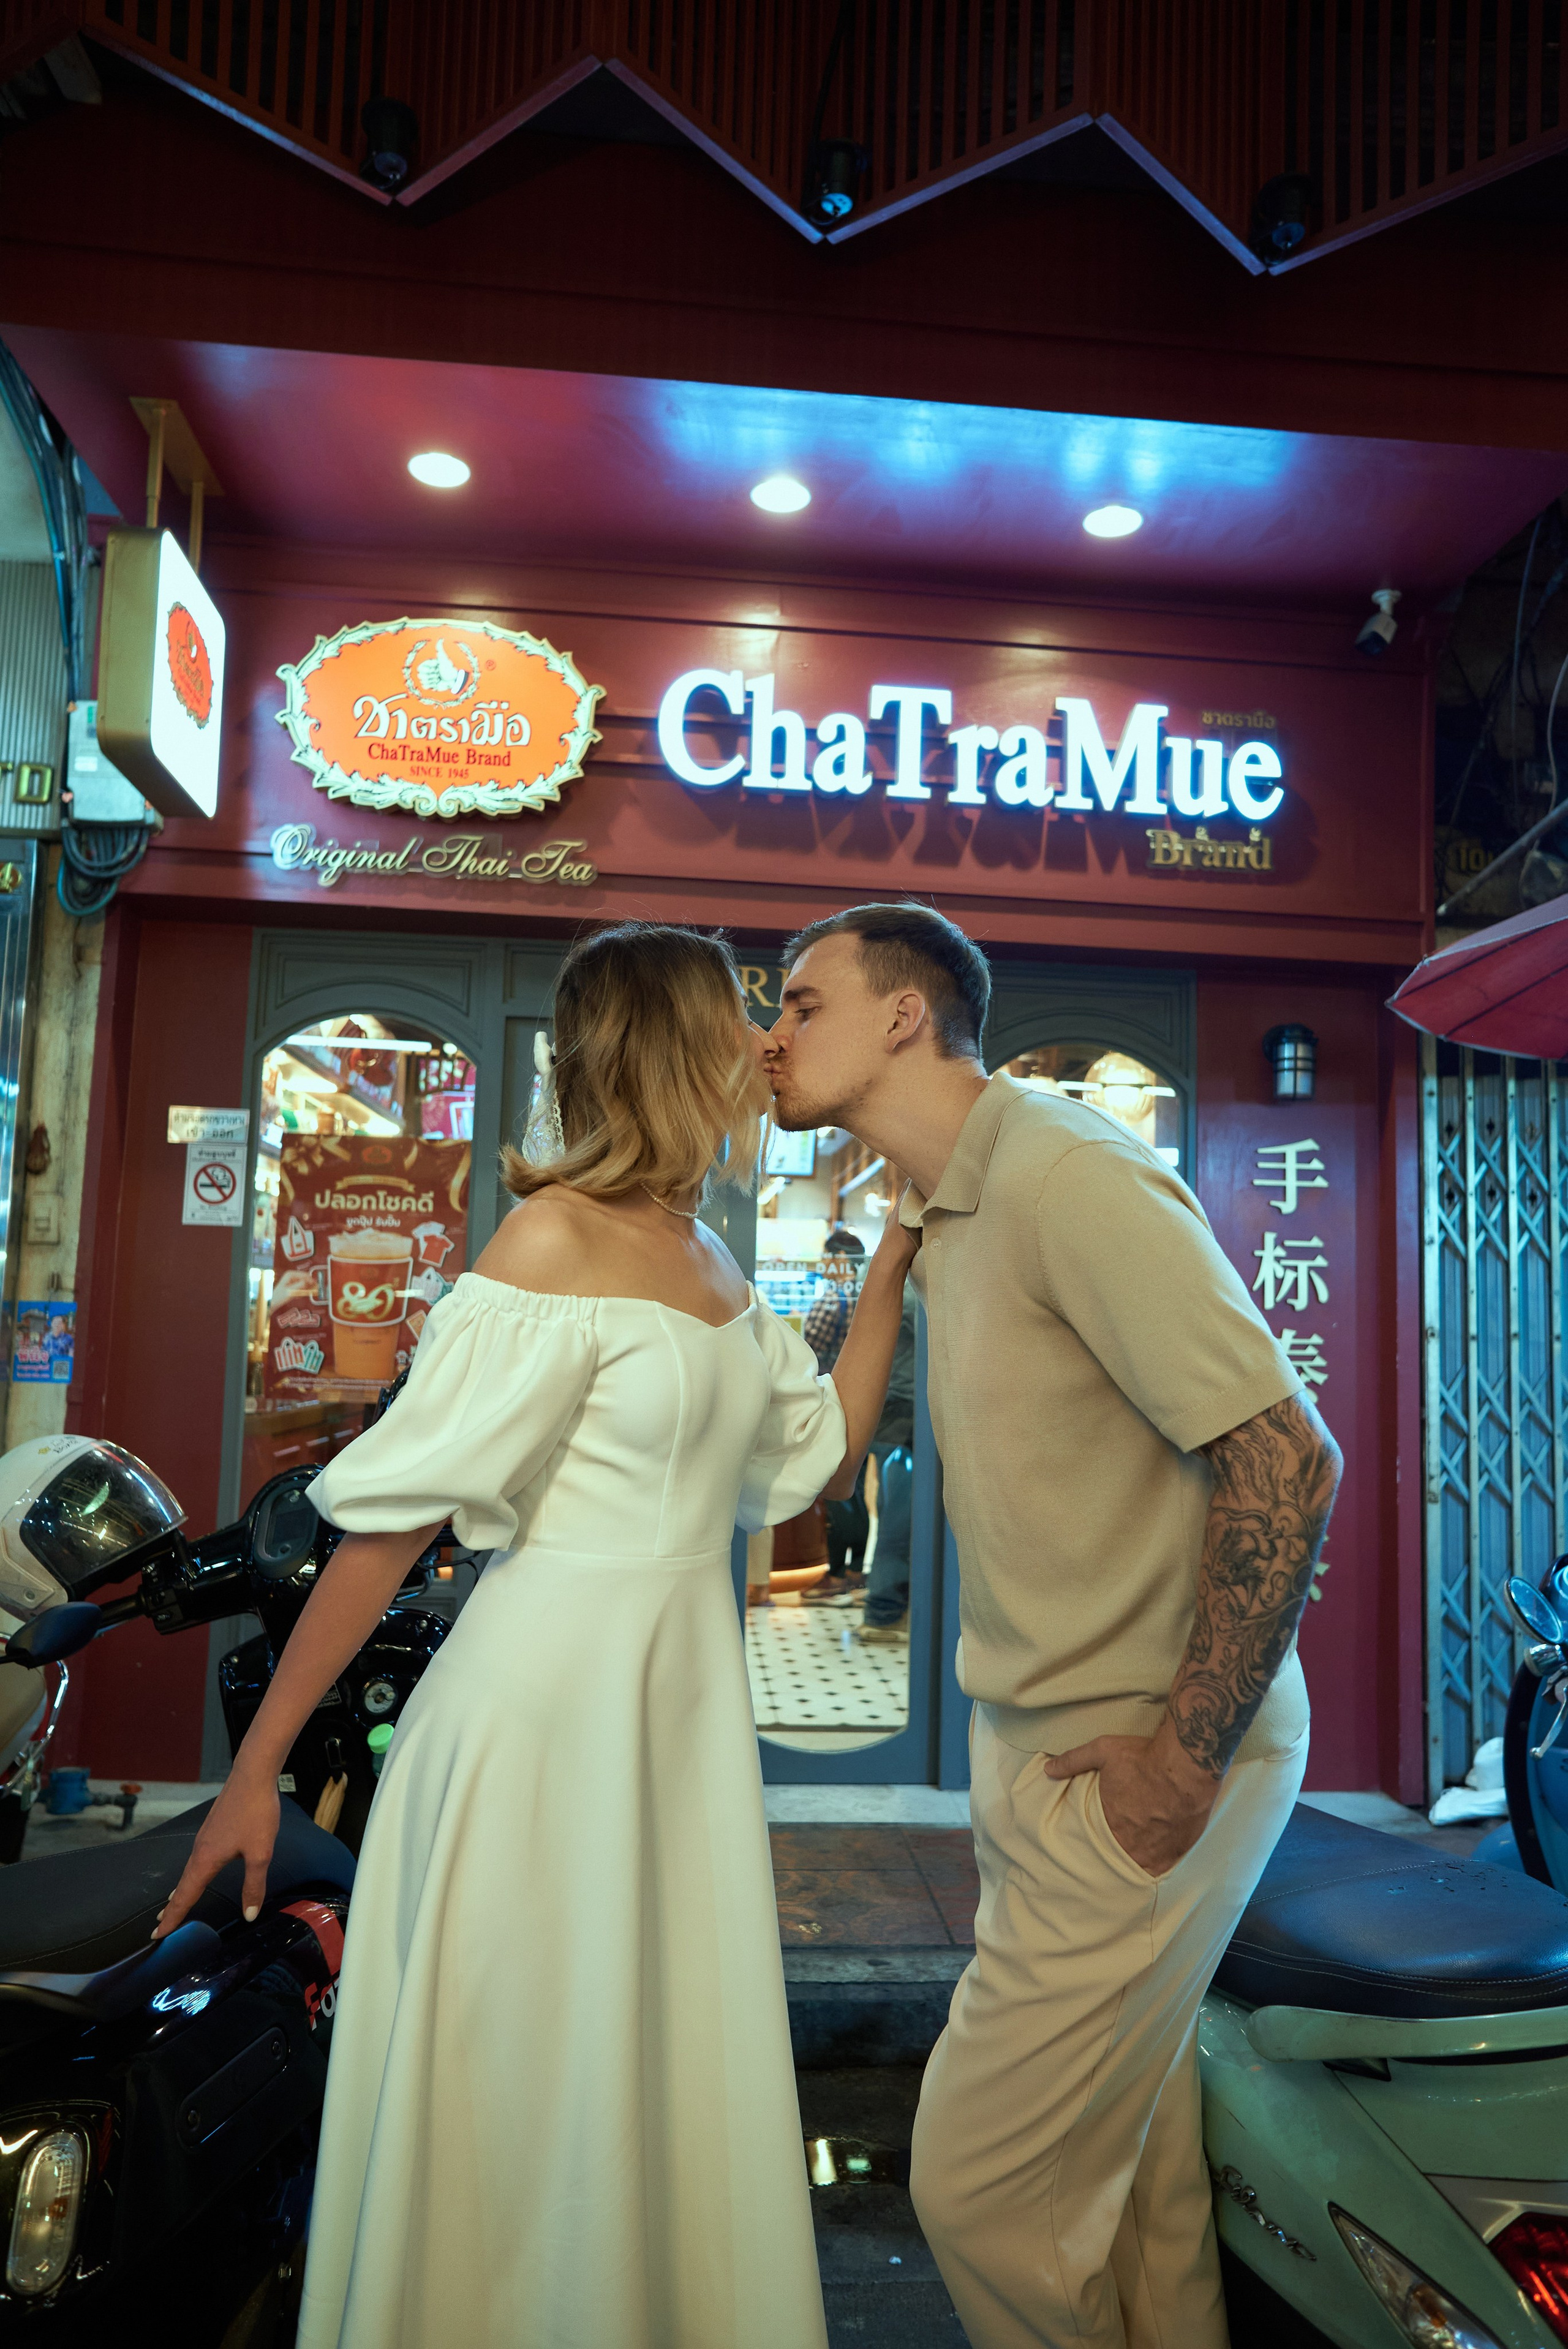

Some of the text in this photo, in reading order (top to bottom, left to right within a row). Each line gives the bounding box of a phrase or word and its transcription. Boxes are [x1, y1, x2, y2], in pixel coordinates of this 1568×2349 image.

[353, 692, 531, 747] ชาตรามือ
[368, 742, 511, 767] ChaTraMue Brand
[657, 668, 1284, 820] ChaTraMue
[410, 766, 469, 779] SINCE 1945
[273, 824, 595, 886] Original Thai Tea
[1150, 829, 1272, 870] Brand
[315, 1189, 434, 1213] ปลอกโชคดี
[762, 1261, 865, 1275] OPEN DAILY
